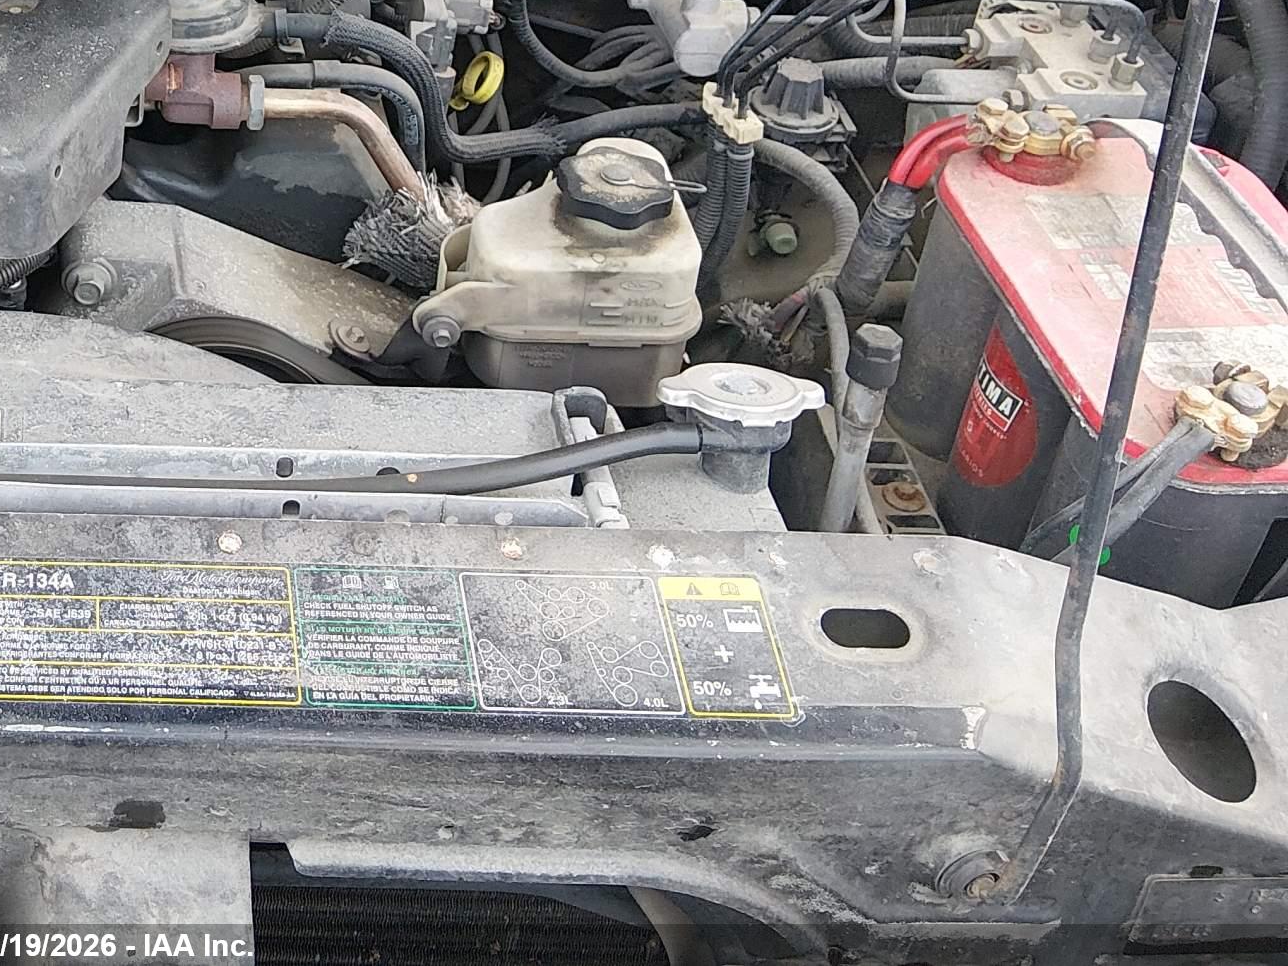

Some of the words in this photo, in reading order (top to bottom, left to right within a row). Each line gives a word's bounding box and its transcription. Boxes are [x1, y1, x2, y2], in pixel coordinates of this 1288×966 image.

[2, 572, 76, 589] R-134A
[589, 580, 613, 590] 3.0L
[303, 601, 332, 610] CHECK
[332, 602, 355, 610] FUEL
[355, 602, 393, 611] SHUTOFF
[393, 604, 426, 613] SWITCH
[426, 605, 439, 613] AS
[37, 608, 62, 619] SAE
[303, 609, 359, 619] REFERENCED
[369, 611, 393, 620] YOUR
[394, 612, 426, 621] OWNER
[676, 614, 714, 629] 50%
[345, 635, 357, 643] LA
[357, 635, 406, 644] COMMANDE
[406, 636, 419, 645] DE
[419, 636, 460, 646] COUPURE
[374, 644, 406, 652] COMME
[333, 650, 345, 658] LE
[345, 651, 372, 659] GUIDE
[372, 651, 384, 660] DE
[128, 687, 146, 695] POR
[146, 687, 188, 696] PERSONAL
[390, 685, 417, 694] COMO
[417, 686, 430, 694] SE
[431, 686, 460, 695] INDICA
[693, 681, 732, 697] 50%
[312, 691, 325, 700] EN
[326, 691, 338, 700] LA
[360, 692, 378, 701] DEL
[546, 694, 573, 706] 2.3L
[643, 697, 669, 709] 4.0L
